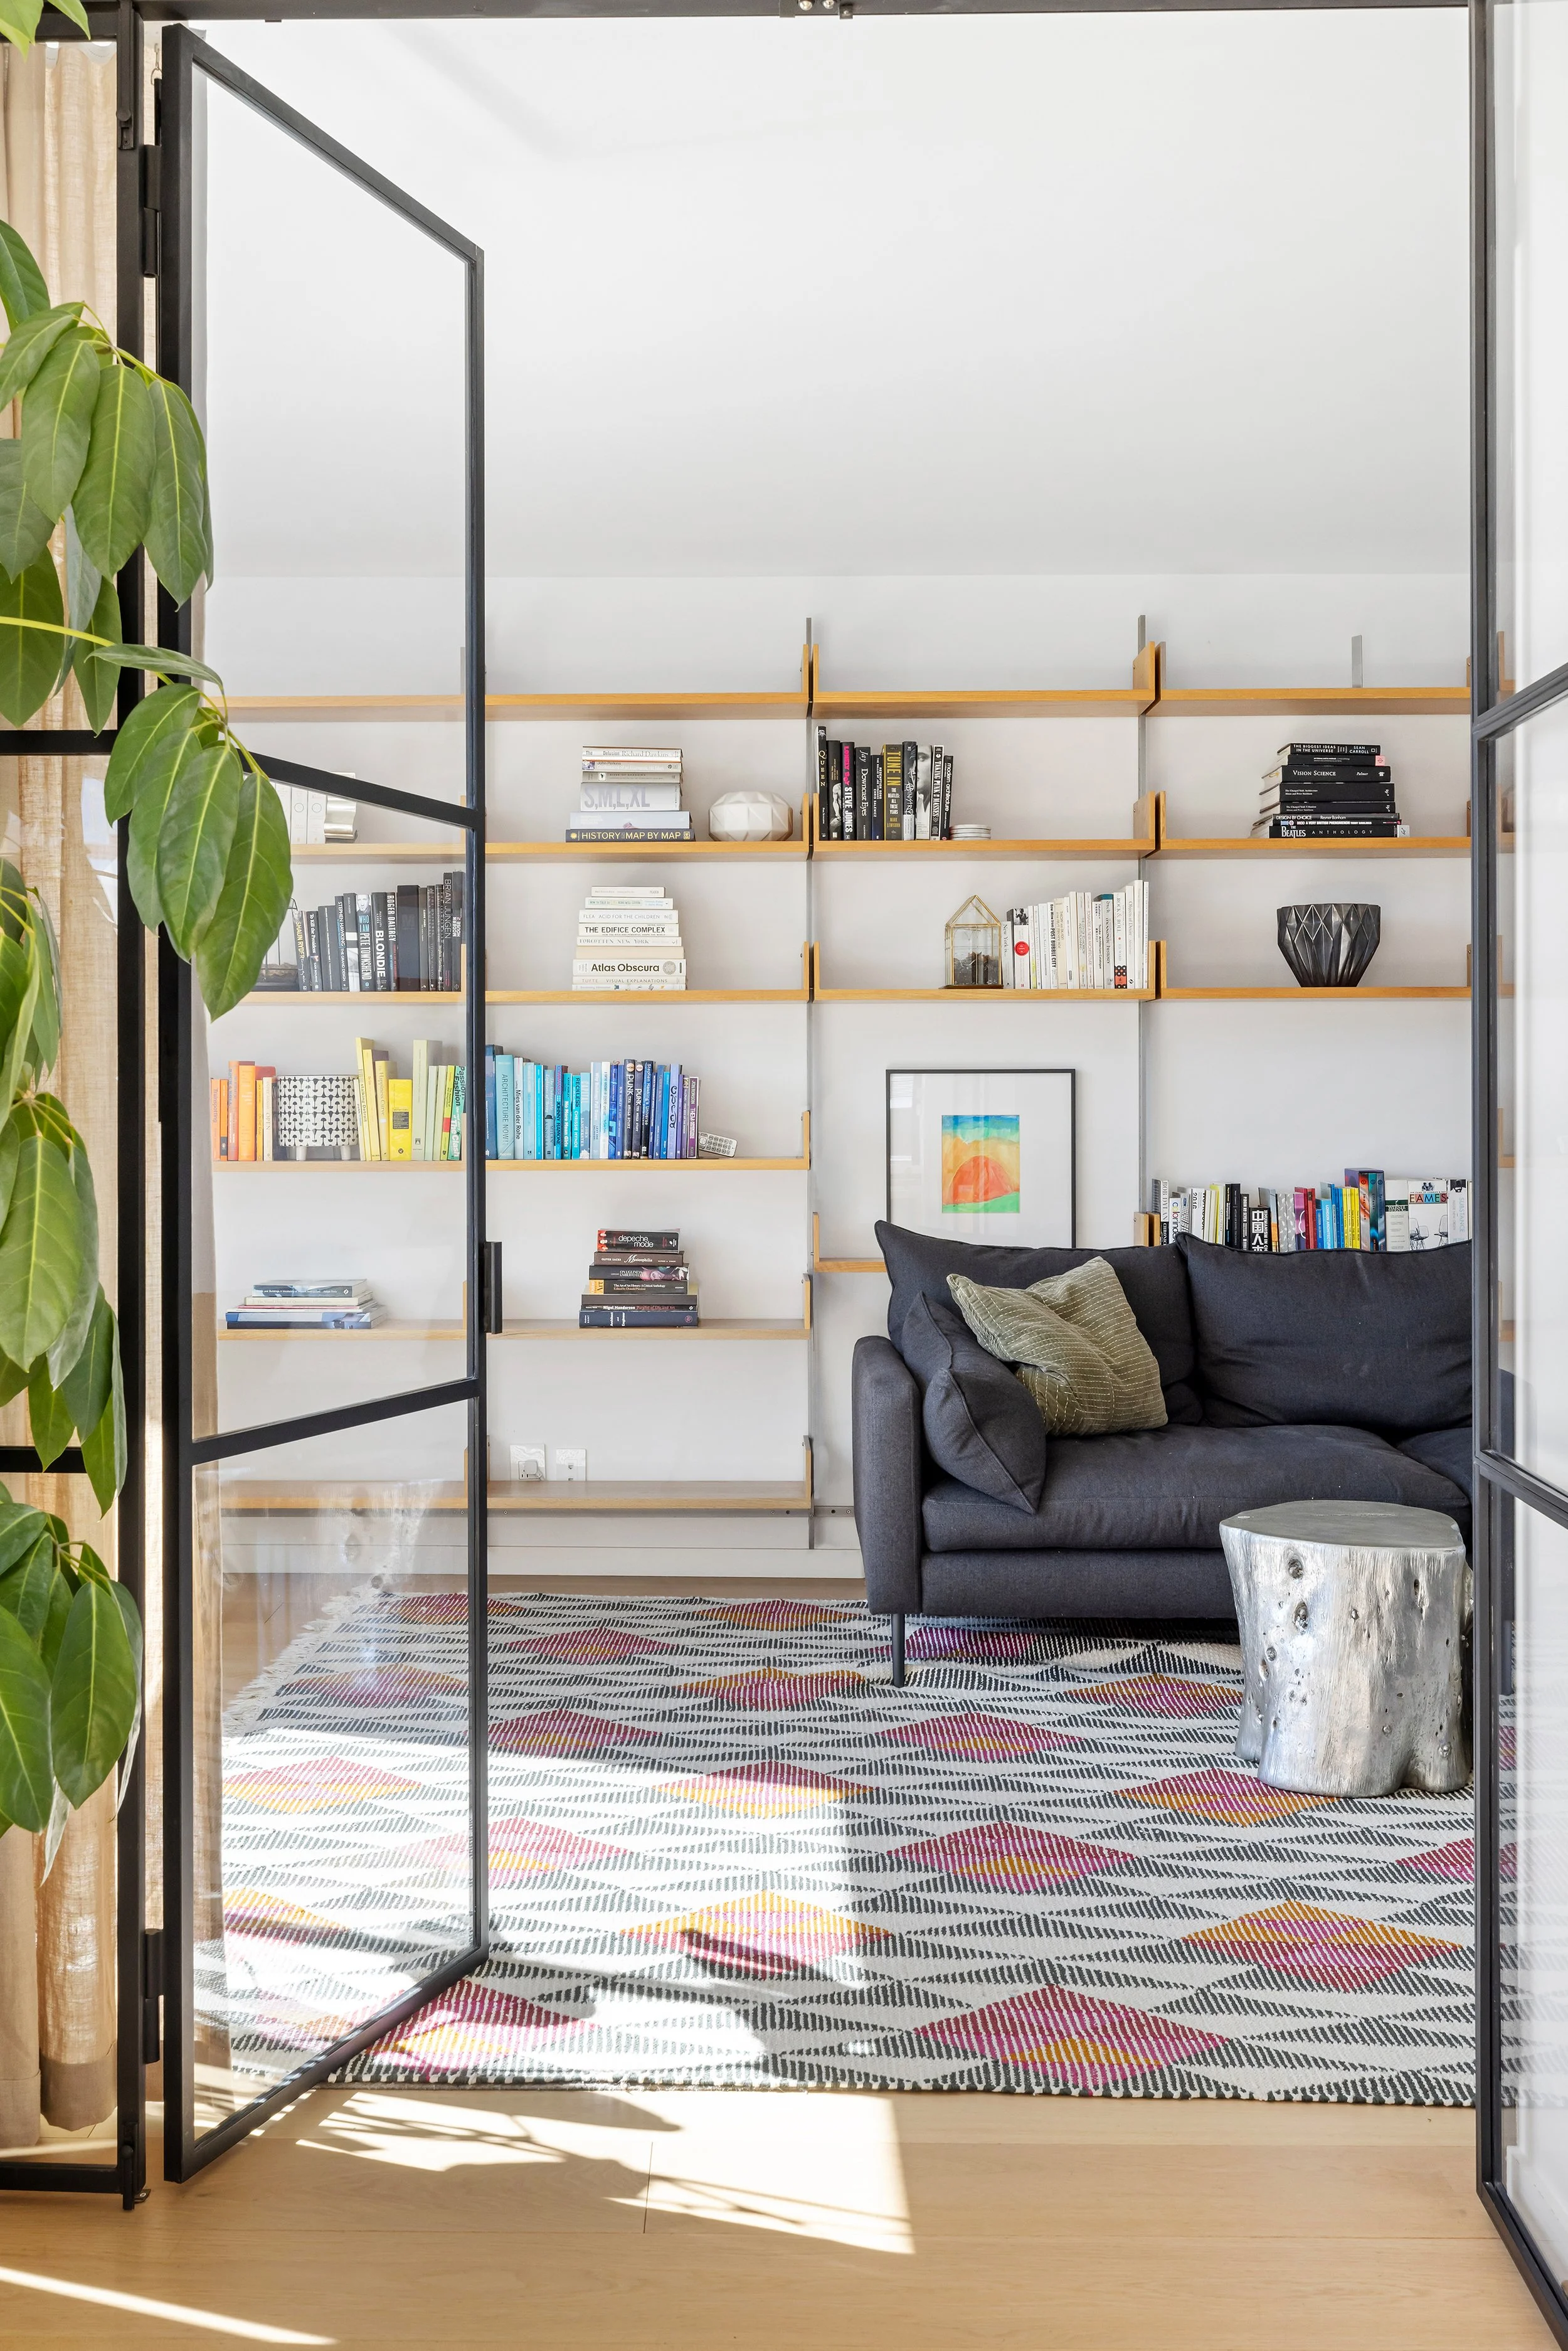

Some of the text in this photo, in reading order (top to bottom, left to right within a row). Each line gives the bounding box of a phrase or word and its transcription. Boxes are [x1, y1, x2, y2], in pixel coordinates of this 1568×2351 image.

[859, 750, 868, 762] Jay
[818, 750, 827, 787] QUEEN
[887, 751, 901, 786] TUNE IN
[584, 785, 650, 810] S,M,L,XL
[844, 787, 853, 832] STEVE JONES
[581, 832, 681, 840] HISTORY MAP BY MAP
[1281, 826, 1306, 838] BEATLES
[387, 895, 395, 915] ROGER
[359, 915, 369, 923] WHO
[295, 921, 304, 941] SHAUN
[362, 924, 369, 932] AM
[360, 933, 372, 980] PETE TOWNSHEND
[376, 930, 386, 977] BLONDIE
[591, 963, 616, 972] Atlas
[617, 963, 660, 972] Obscura
[458, 1066, 467, 1096] Passion
[1410, 1194, 1446, 1202] EAMES
[618, 1234, 649, 1244] depeche
[633, 1239, 654, 1248] mode
[623, 1254, 653, 1263] Musicophilia
